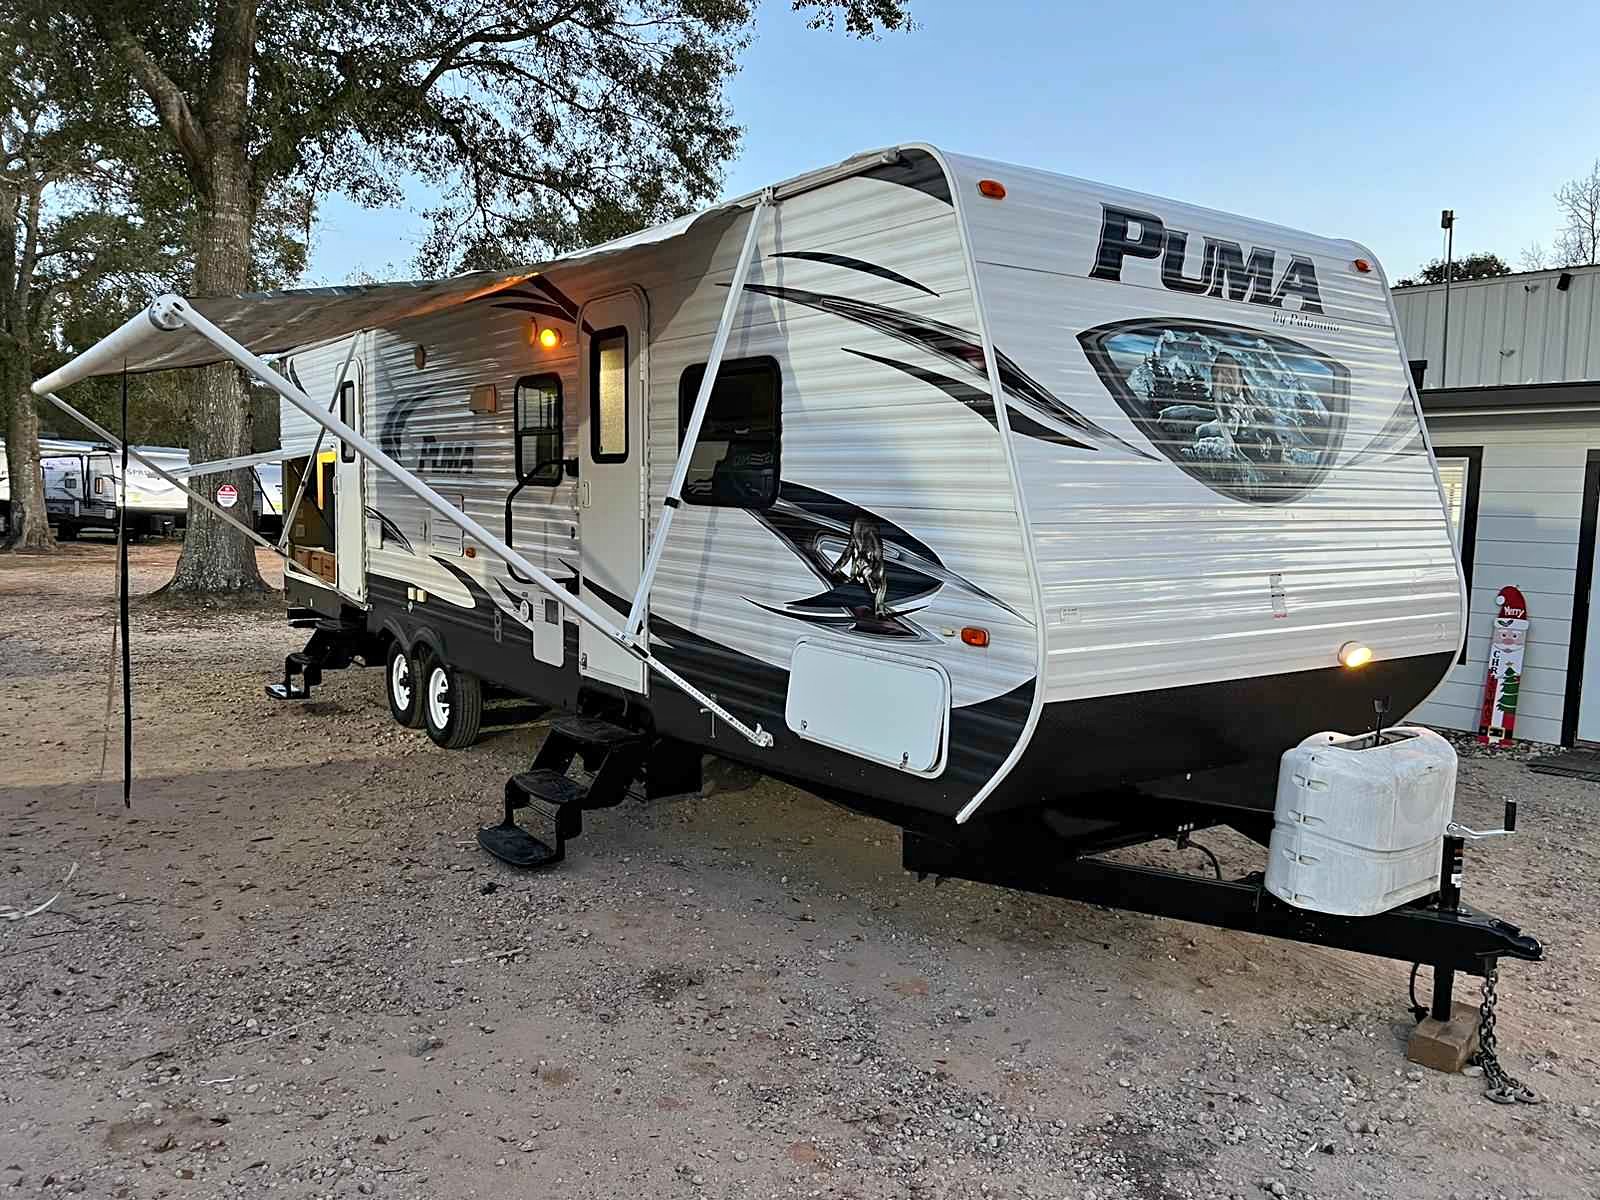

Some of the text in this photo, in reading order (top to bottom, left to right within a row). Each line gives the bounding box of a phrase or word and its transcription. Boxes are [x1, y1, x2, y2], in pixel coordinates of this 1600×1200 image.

[1088, 202, 1324, 314] PUMA
[1272, 310, 1287, 327] by
[416, 435, 474, 474] PUMA
[1503, 605, 1525, 618] Merry
